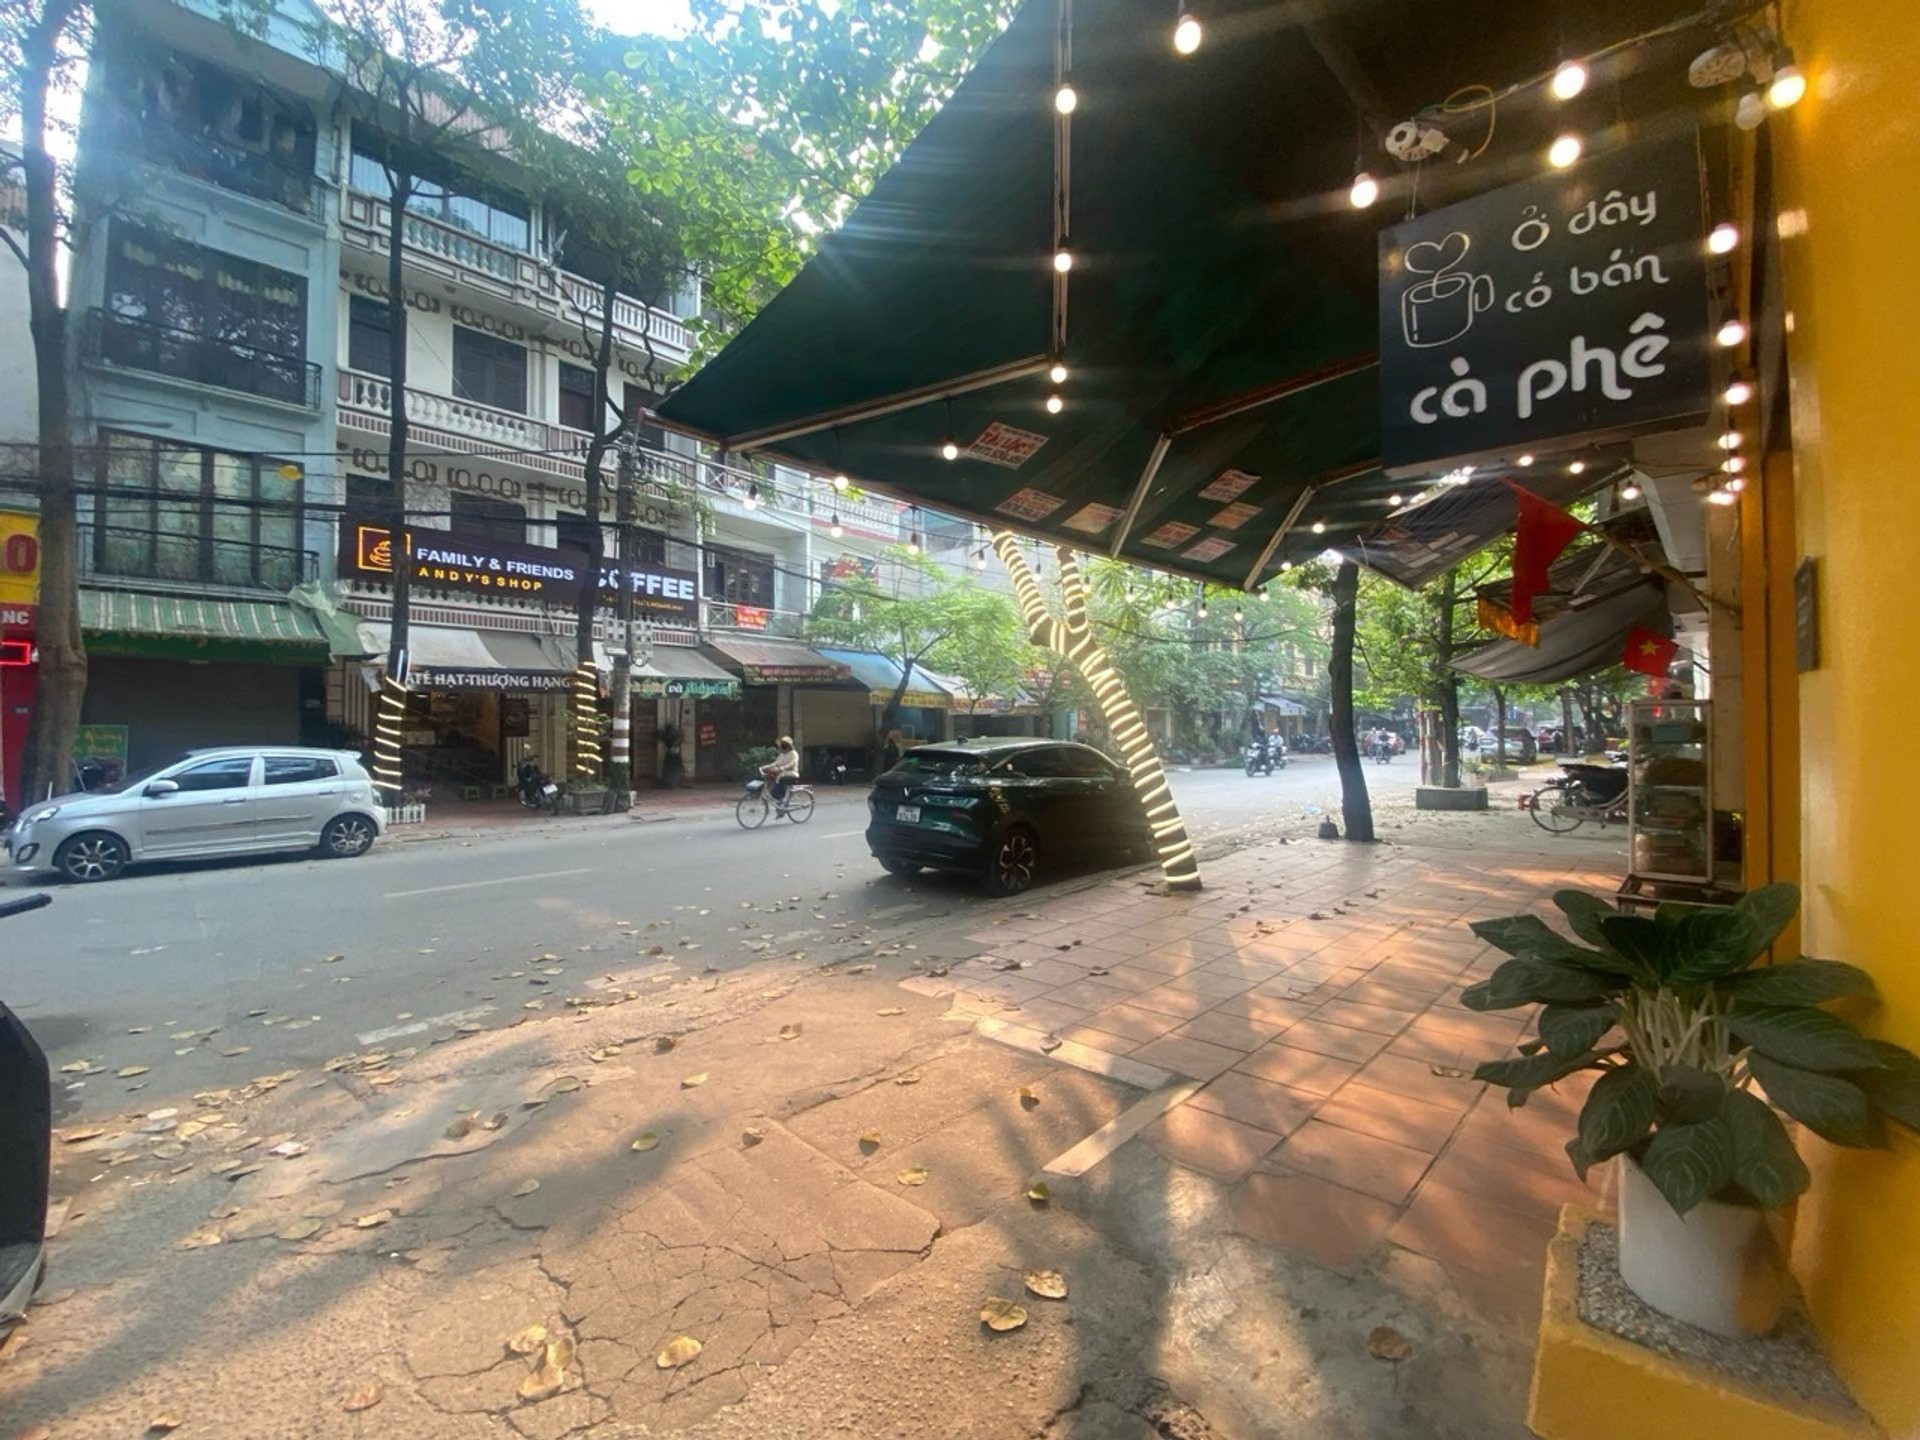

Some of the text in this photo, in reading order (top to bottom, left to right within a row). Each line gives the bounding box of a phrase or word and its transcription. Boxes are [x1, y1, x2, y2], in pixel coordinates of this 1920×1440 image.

[1511, 205, 1550, 251] Ở
[1506, 248, 1670, 313] có bán
[1410, 311, 1670, 424] cà phê
[416, 548, 575, 581] FAMILY & FRIENDS
[418, 567, 543, 591] ANDY'S SHOP
